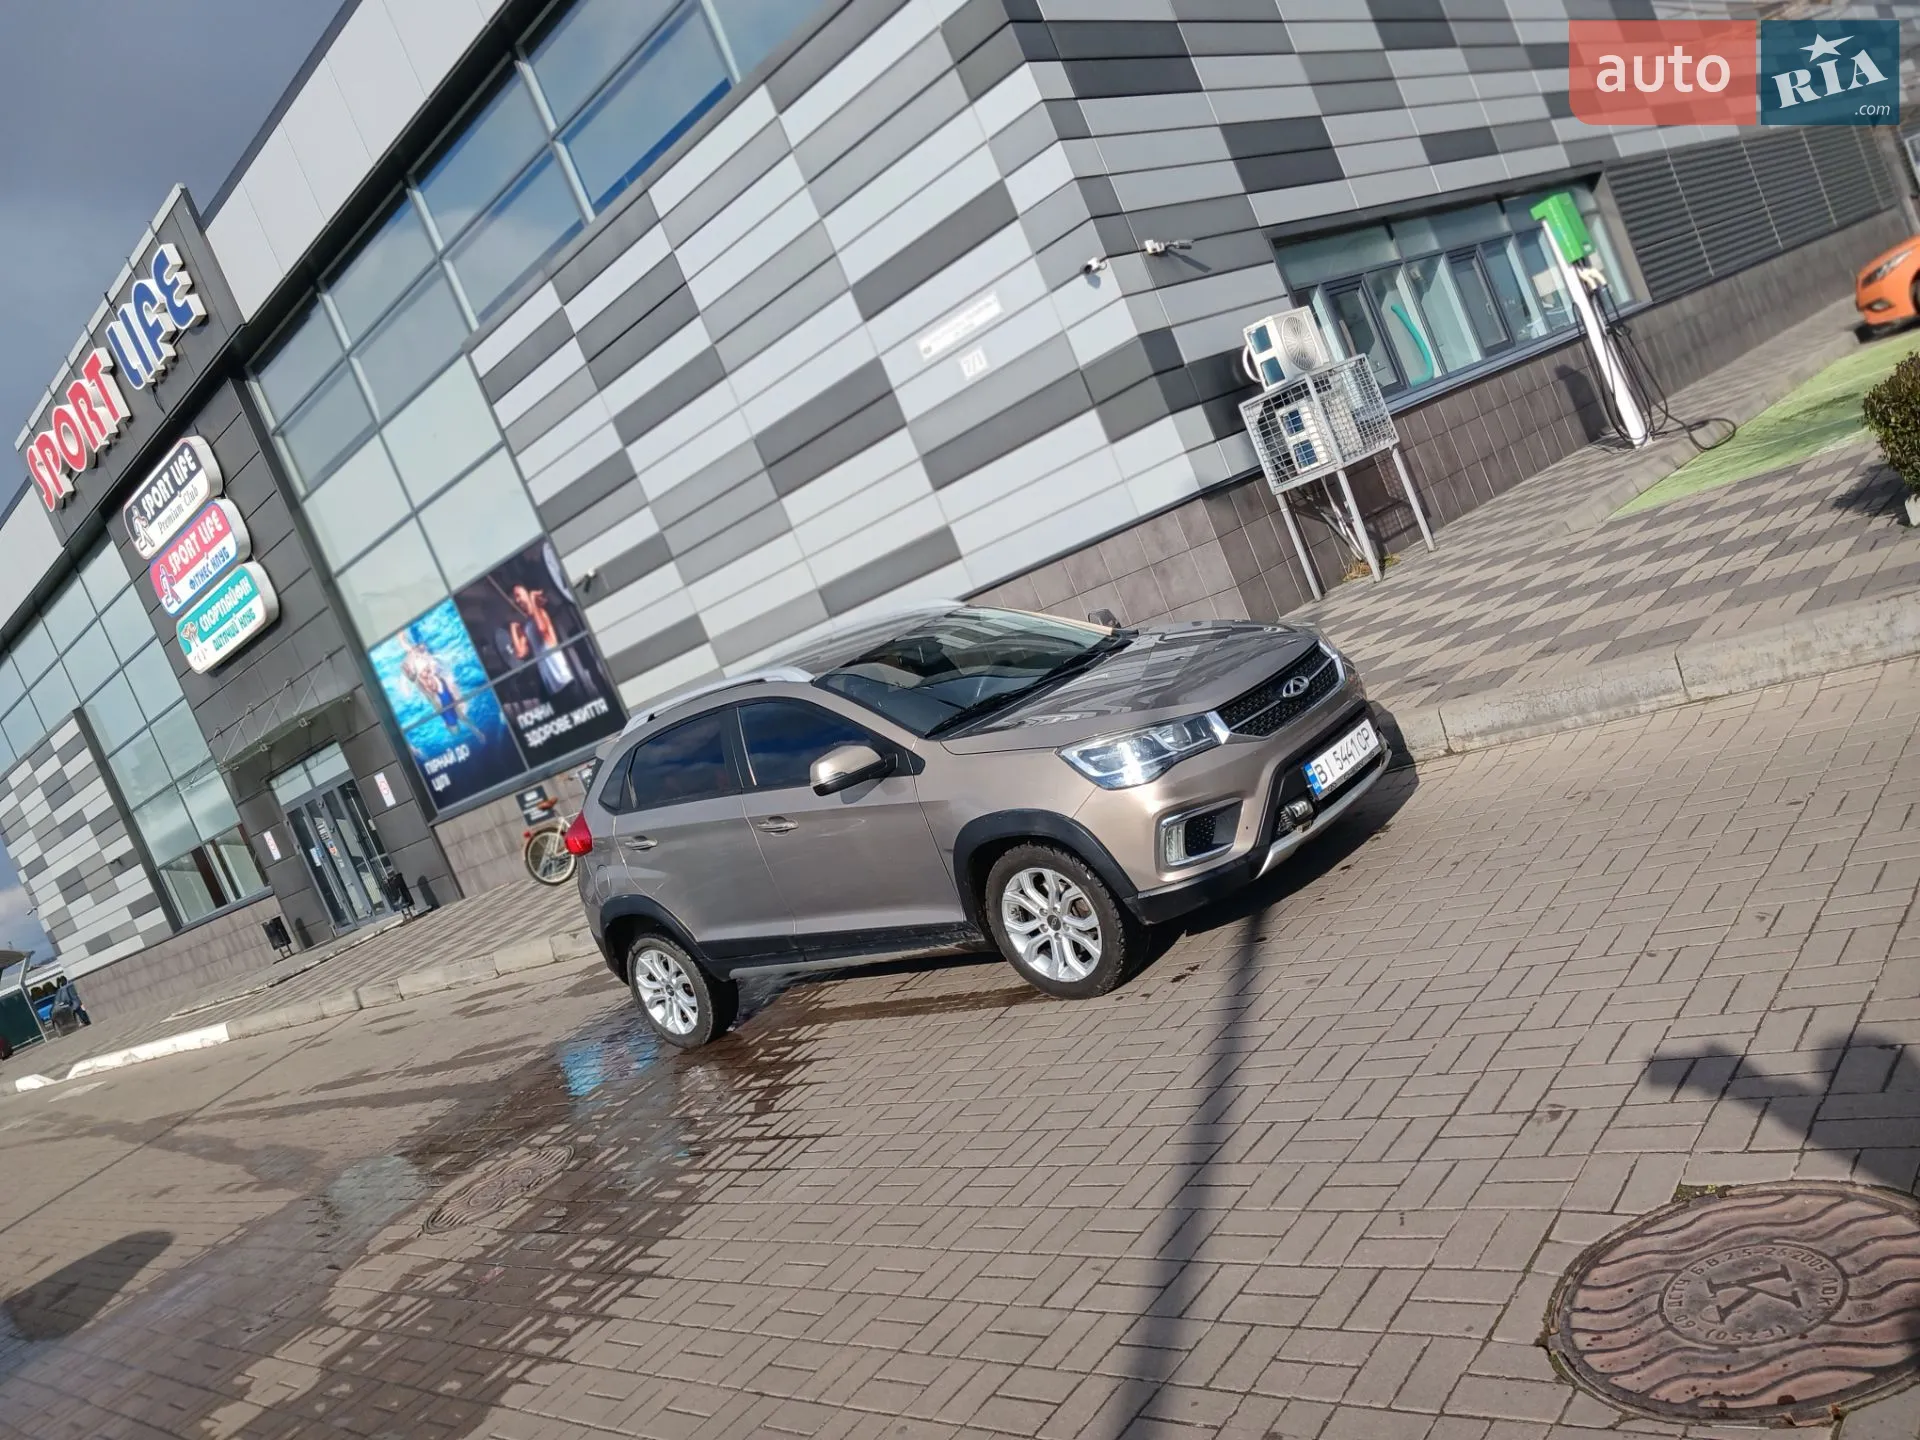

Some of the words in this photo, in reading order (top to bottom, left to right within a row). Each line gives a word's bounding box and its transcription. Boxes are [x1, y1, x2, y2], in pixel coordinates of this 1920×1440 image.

[27, 348, 126, 512] SPORT
[105, 243, 203, 390] LIFE
[141, 471, 176, 520] SPORT
[171, 447, 197, 486] LIFE
[157, 504, 184, 535] Premium
[183, 485, 199, 509] Club
[168, 529, 203, 575] SPORT
[200, 509, 224, 546] LIFE
[188, 561, 212, 591] ФІТНЕС
[211, 546, 230, 575] КЛУБ
[212, 618, 240, 652] ДИТЯЧИЙ
[239, 607, 257, 632] КЛУБ
[516, 702, 555, 730] ПОЧНИ
[523, 715, 573, 748] ЗДОРОВЕ
[569, 697, 610, 729] ЖИТТЯ
[454, 743, 471, 763] ДО
[1314, 759, 1335, 785] BI
[1332, 738, 1361, 771] 5441
[1356, 727, 1370, 751] CP
[1668, 1278, 1691, 1309] ДСТУ
[1817, 1277, 1839, 1306] ЛЮК
